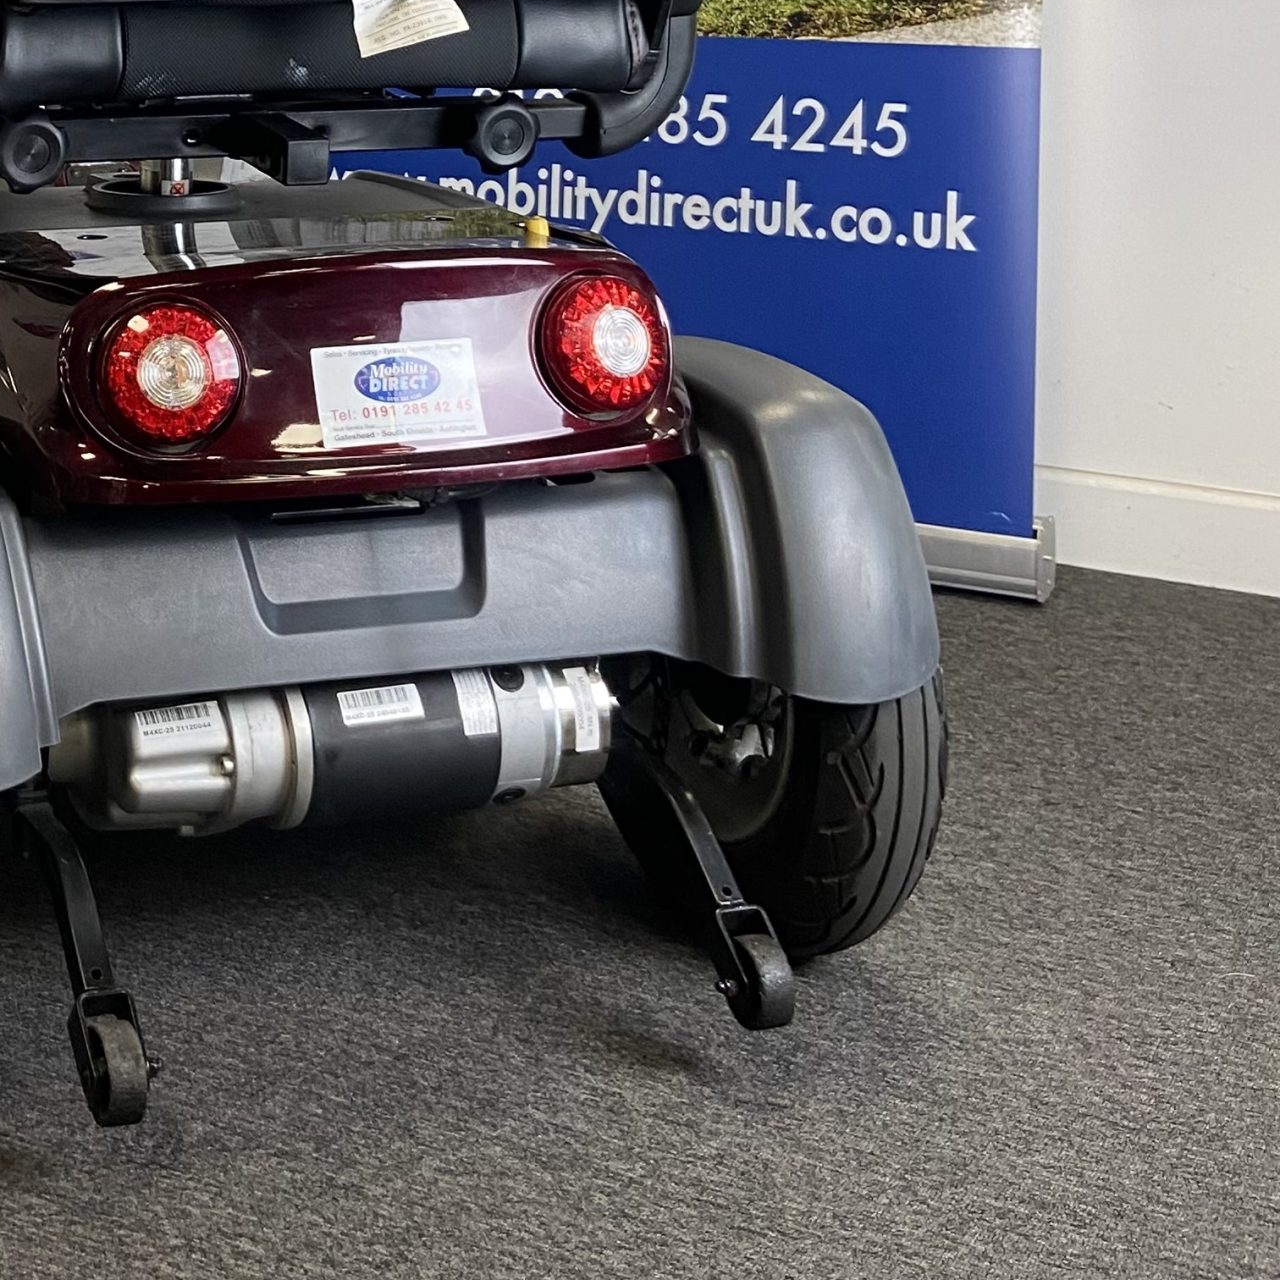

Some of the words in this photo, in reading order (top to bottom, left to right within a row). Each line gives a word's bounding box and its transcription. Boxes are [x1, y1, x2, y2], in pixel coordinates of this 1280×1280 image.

[642, 94, 727, 147] 85
[750, 96, 909, 158] 4245
[330, 163, 978, 252] obilitydirectuk.co.uk
[370, 361, 428, 378] Mobility
[369, 375, 428, 393] DIRECT
[362, 405, 397, 419] 0191
[404, 402, 429, 415] 285
[456, 399, 473, 411] 45
[334, 431, 375, 442] Gateshead
